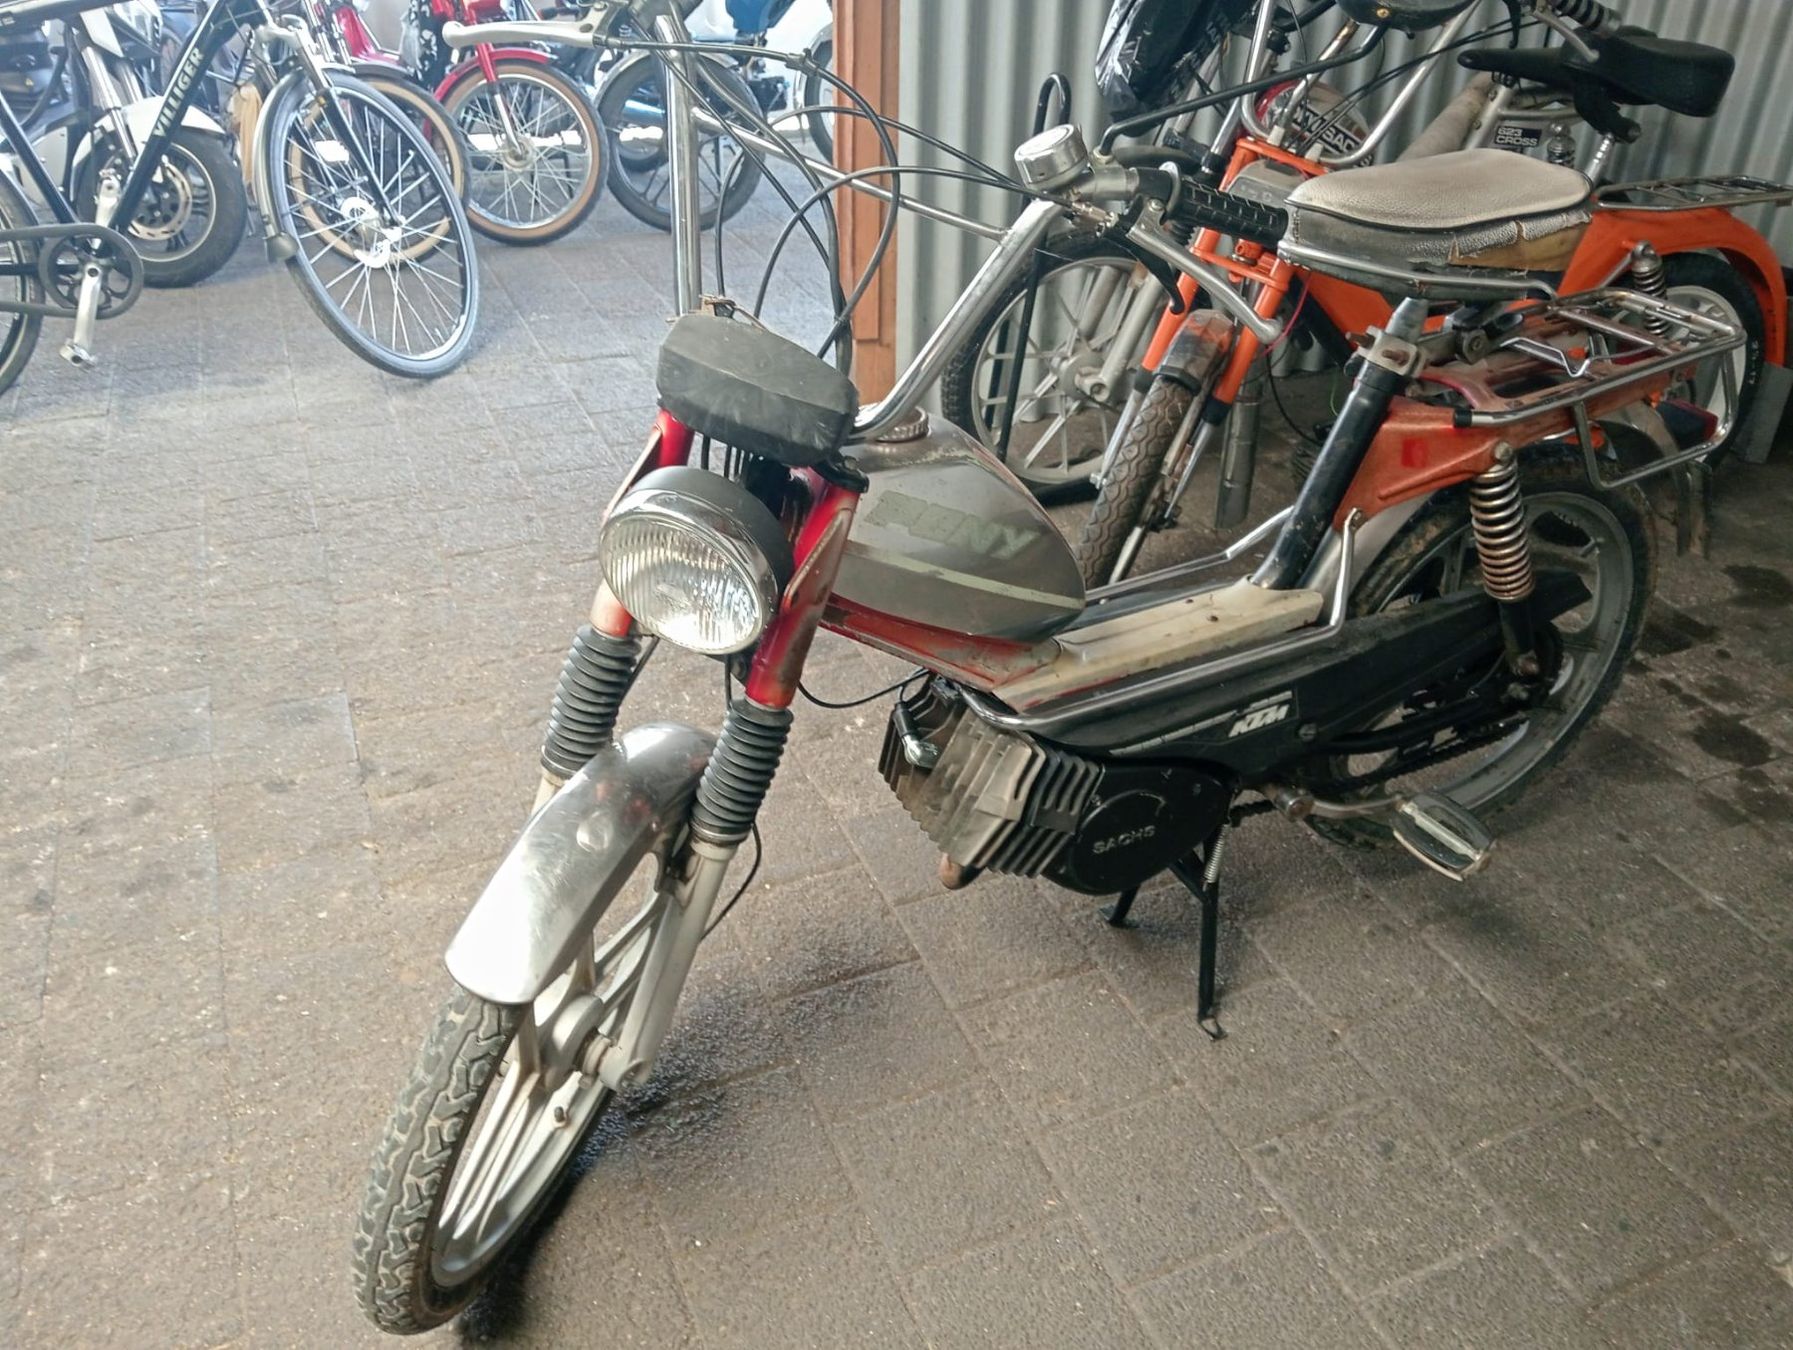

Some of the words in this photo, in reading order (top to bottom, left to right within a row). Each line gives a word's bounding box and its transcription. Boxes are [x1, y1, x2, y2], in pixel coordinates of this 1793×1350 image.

[152, 47, 204, 136] VILLIGER
[1496, 135, 1538, 146] CROSS
[1228, 704, 1290, 738] KTM
[1093, 825, 1156, 854] SACHS
